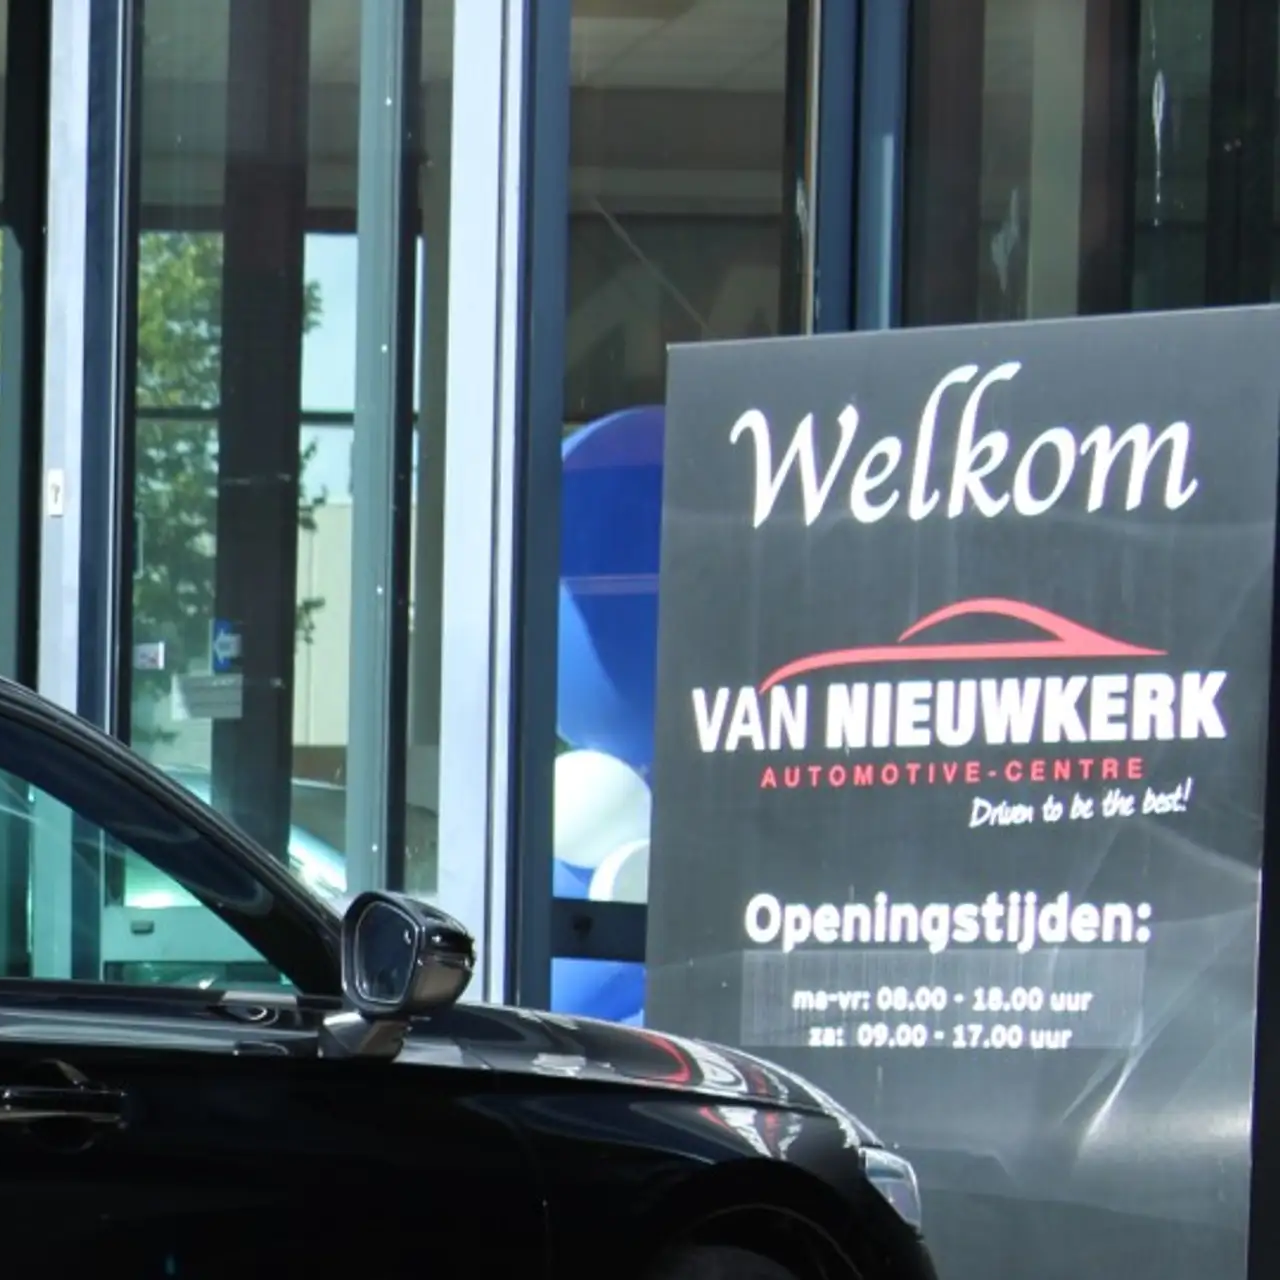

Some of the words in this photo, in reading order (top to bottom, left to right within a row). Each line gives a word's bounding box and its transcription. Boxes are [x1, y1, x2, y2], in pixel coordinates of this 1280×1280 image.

[730, 361, 1198, 528] Welkom
[692, 685, 807, 752] VAN
[826, 670, 1227, 749] NIEUWKERK
[761, 758, 1144, 788] AUTOMOTIVE-CENTRE
[969, 797, 1034, 828] Driven
[1042, 794, 1063, 822] to
[1070, 792, 1094, 819] be
[1102, 788, 1135, 818] the
[1142, 777, 1194, 814] best!
[744, 891, 1152, 954] Openingstijden:
[792, 989, 871, 1011] ma-vr:
[876, 986, 947, 1011] 08.00
[973, 986, 1043, 1011] 18.00
[1050, 991, 1093, 1012] uur
[808, 1026, 845, 1047] za:
[857, 1022, 928, 1047] 09.00
[952, 1023, 1023, 1048] 17.00
[1030, 1029, 1072, 1049] uur
